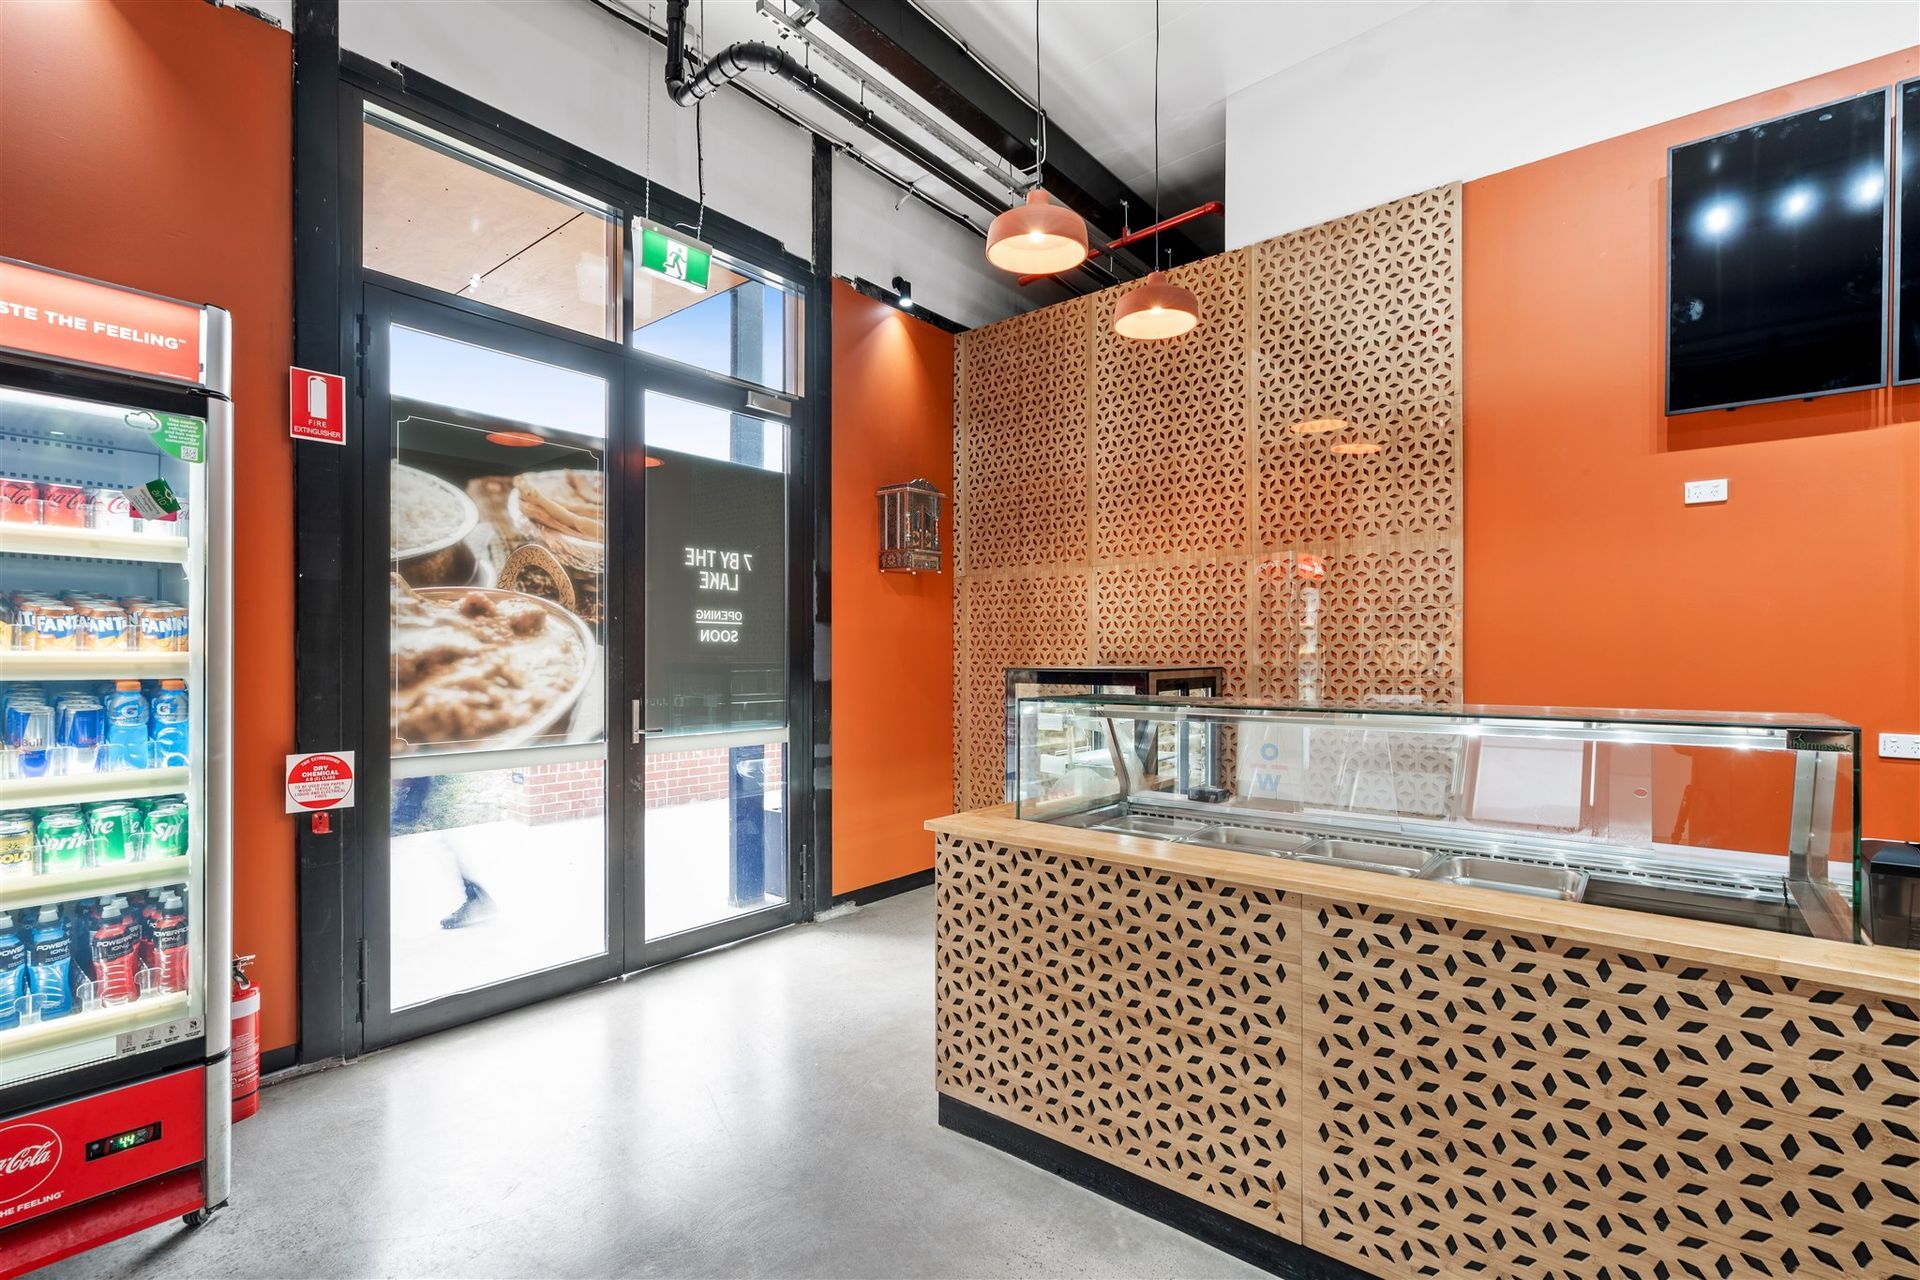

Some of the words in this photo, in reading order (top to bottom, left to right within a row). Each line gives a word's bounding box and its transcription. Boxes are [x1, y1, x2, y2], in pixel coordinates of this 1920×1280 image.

[0, 300, 38, 321] STE
[44, 310, 87, 331] THE
[308, 419, 327, 428] FIRE
[294, 425, 341, 438] EXTINGUISHER
[301, 769, 340, 778] CHEMICAL
[0, 851, 32, 864] OLO
[0, 1206, 15, 1218] HE
